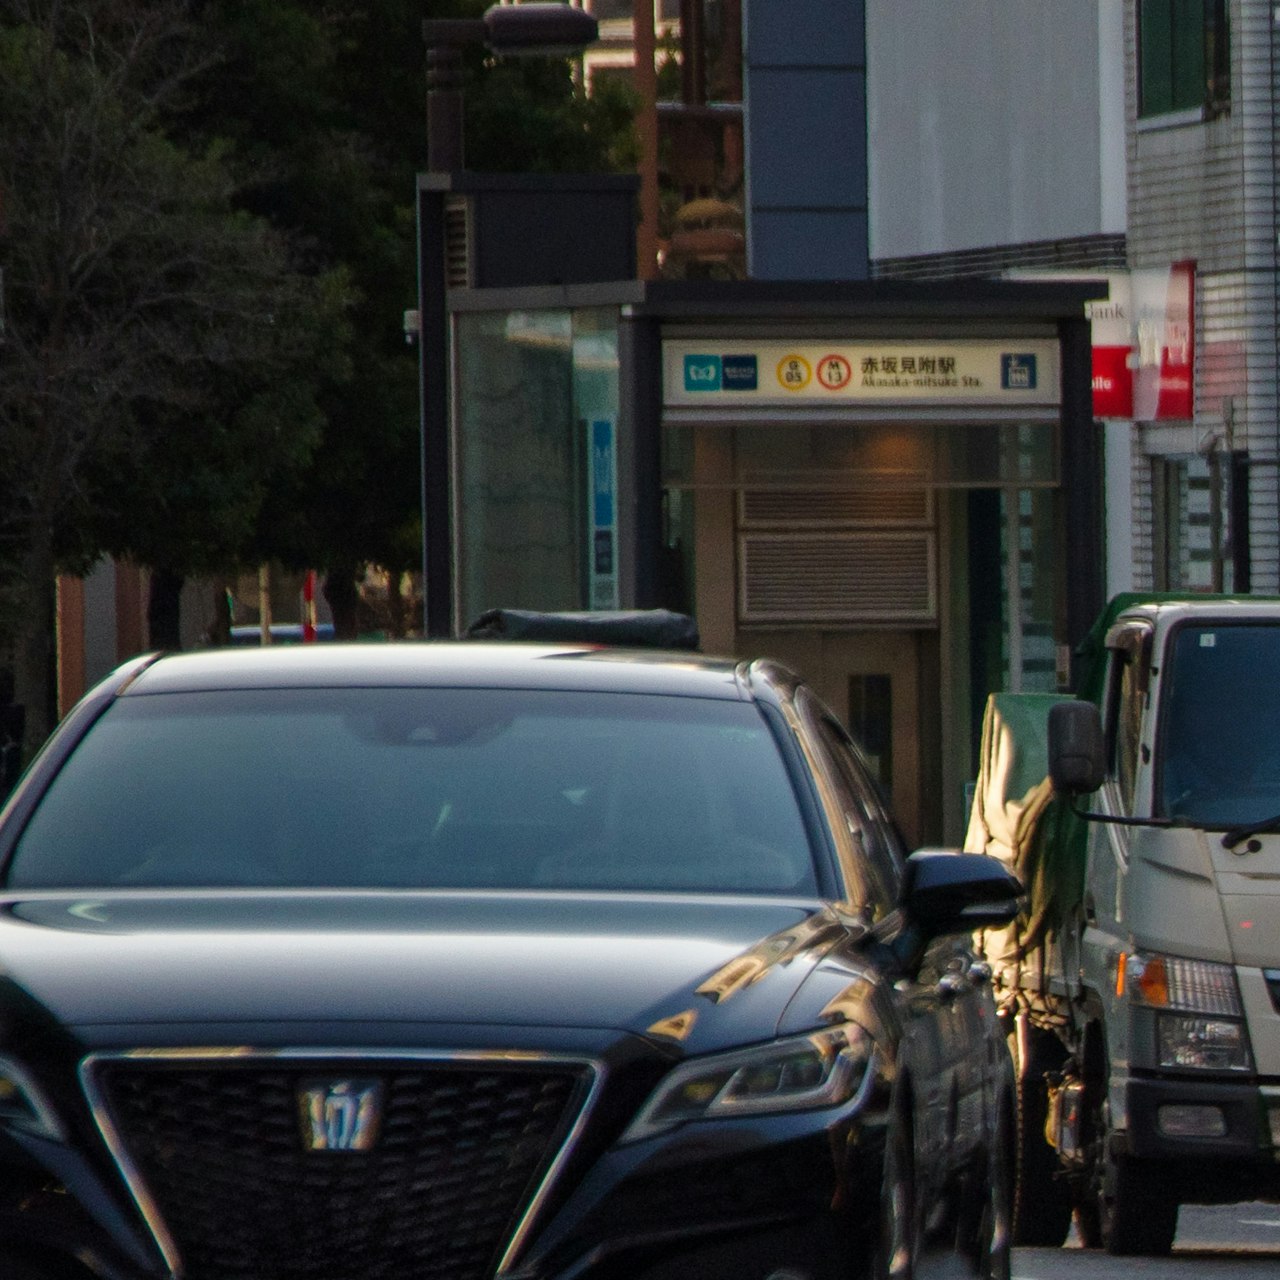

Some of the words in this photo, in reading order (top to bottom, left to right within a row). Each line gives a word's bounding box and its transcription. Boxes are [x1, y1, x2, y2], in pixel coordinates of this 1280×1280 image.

[828, 360, 840, 370] M
[861, 357, 956, 374] 赤坂見附駅
